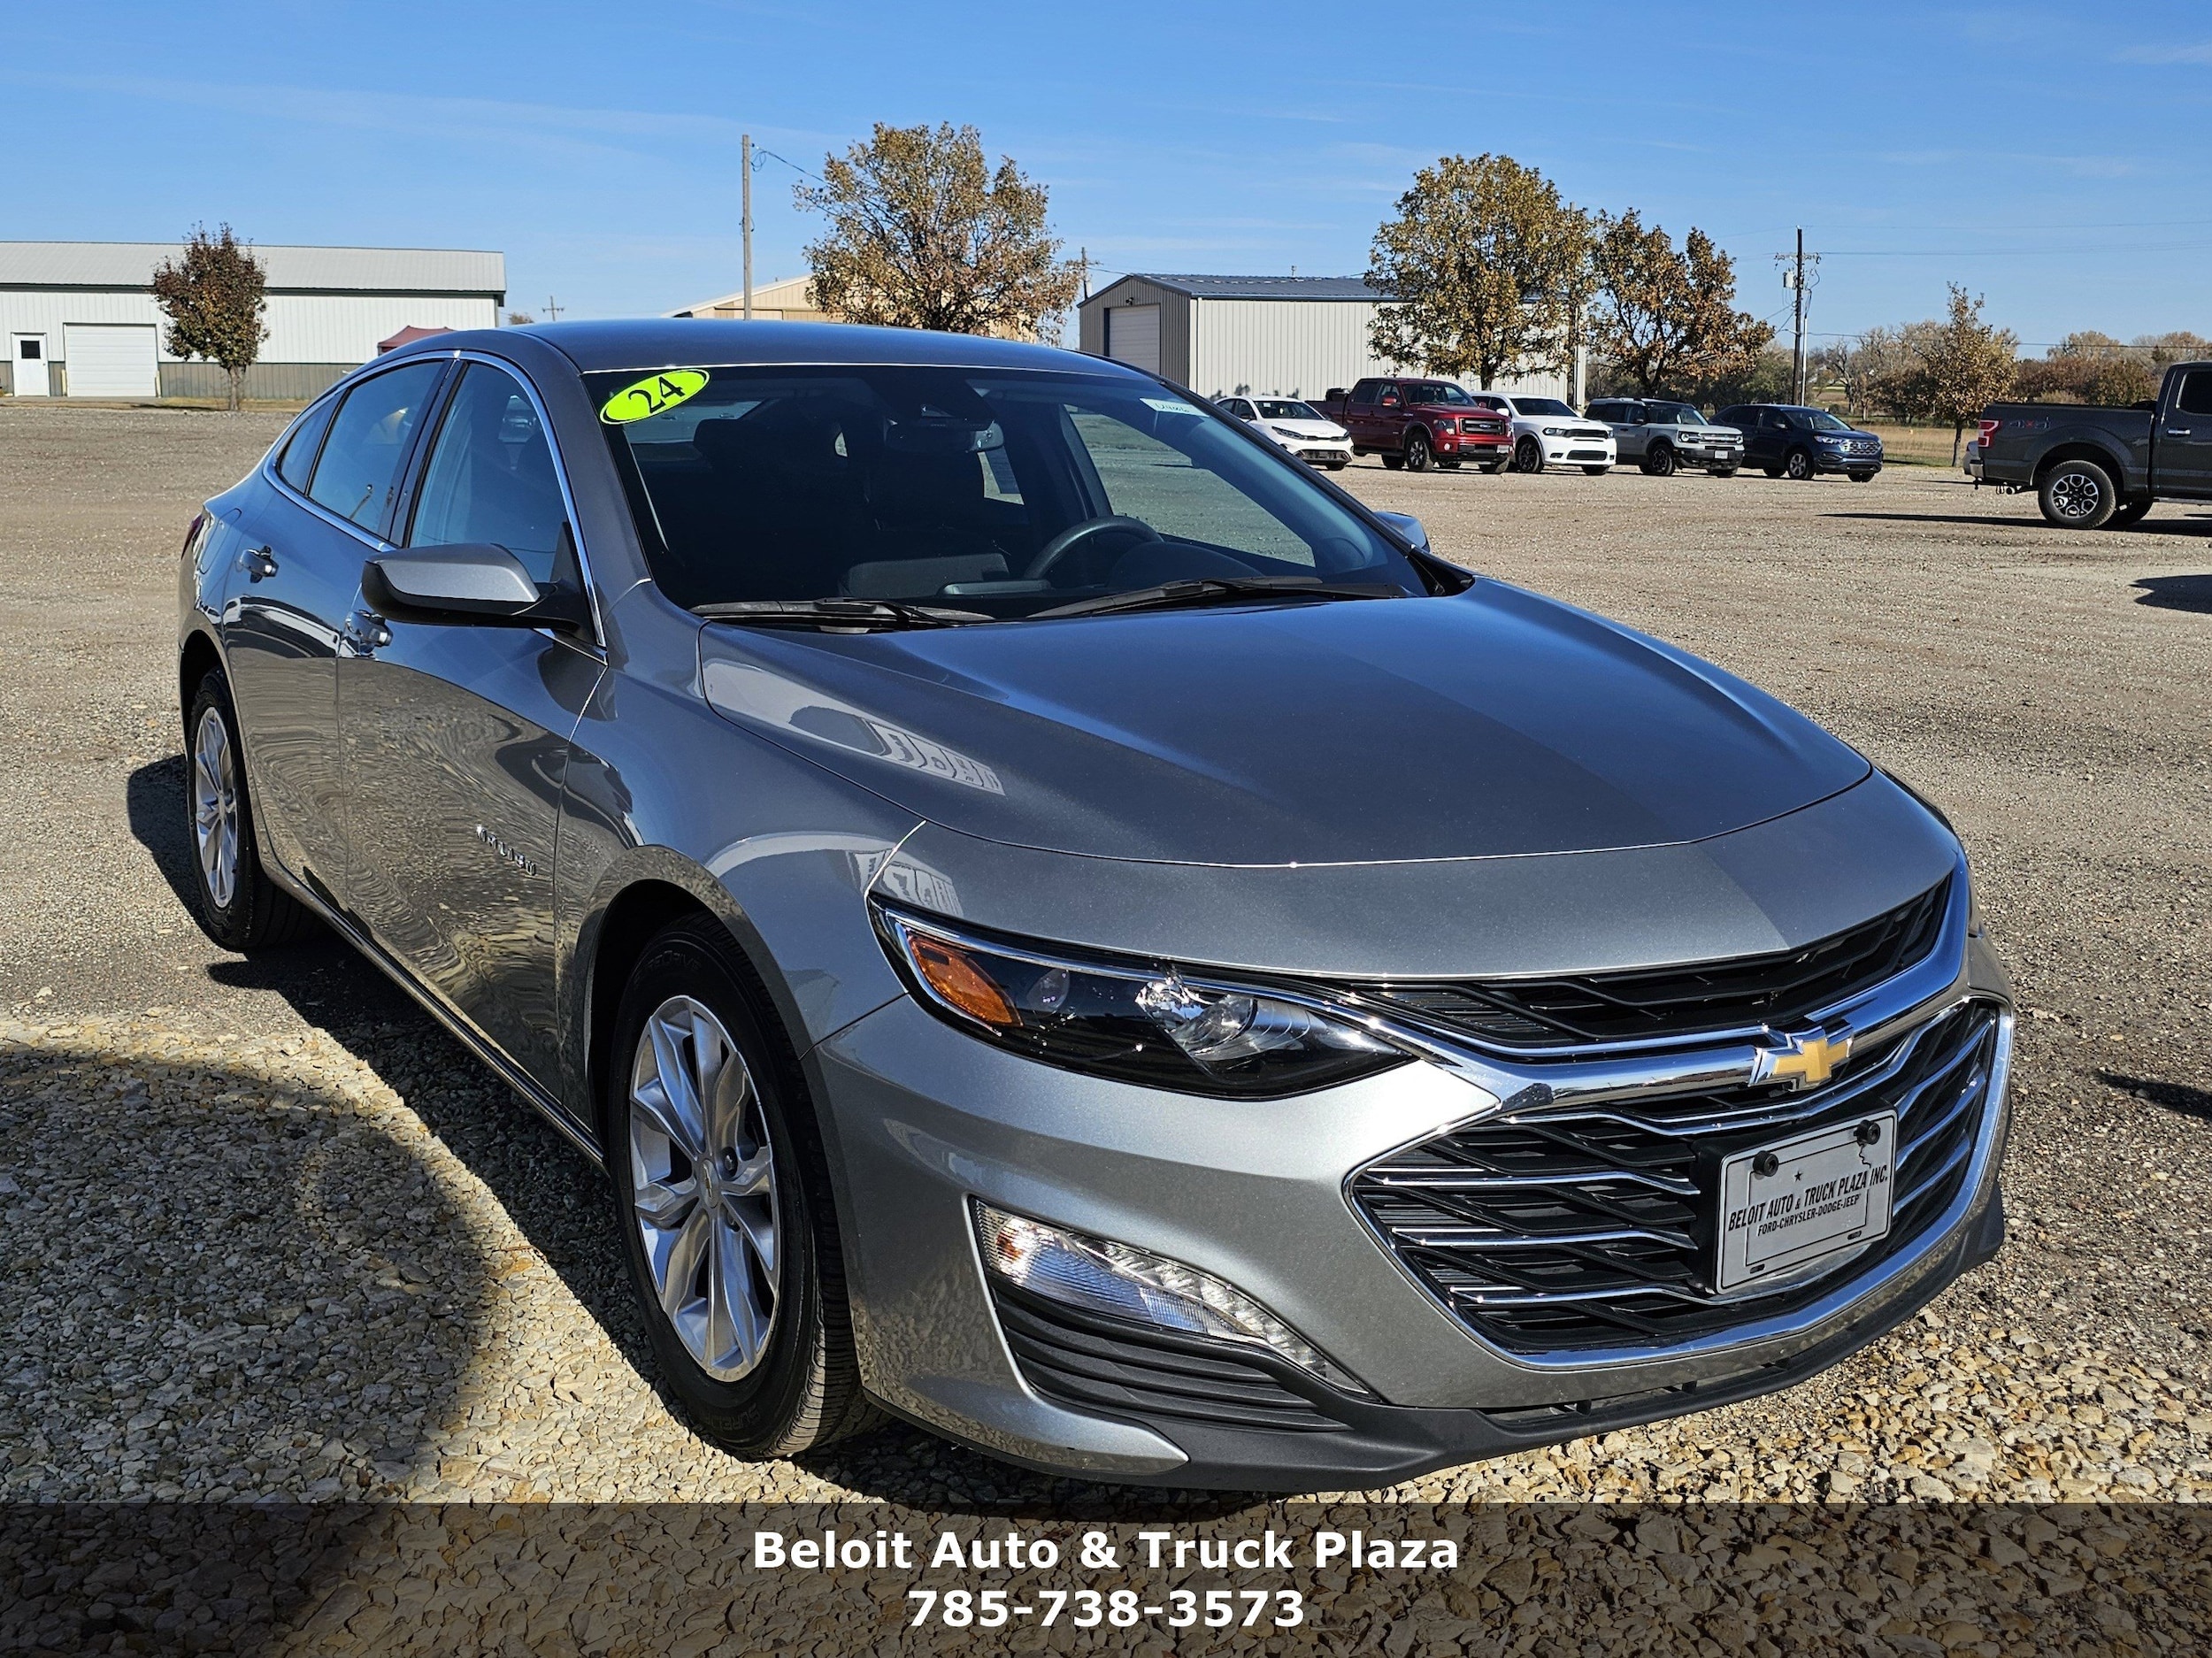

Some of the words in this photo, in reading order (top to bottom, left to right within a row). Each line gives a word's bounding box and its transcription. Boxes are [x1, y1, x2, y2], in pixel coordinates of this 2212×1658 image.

[627, 376, 686, 413] 24
[1728, 1202, 1766, 1232] BELOIT
[1766, 1194, 1793, 1220] AUTO
[1794, 1198, 1801, 1209] &
[1803, 1180, 1837, 1207] TRUCK
[1837, 1171, 1868, 1197] PLAZA
[1869, 1164, 1888, 1186] INC.
